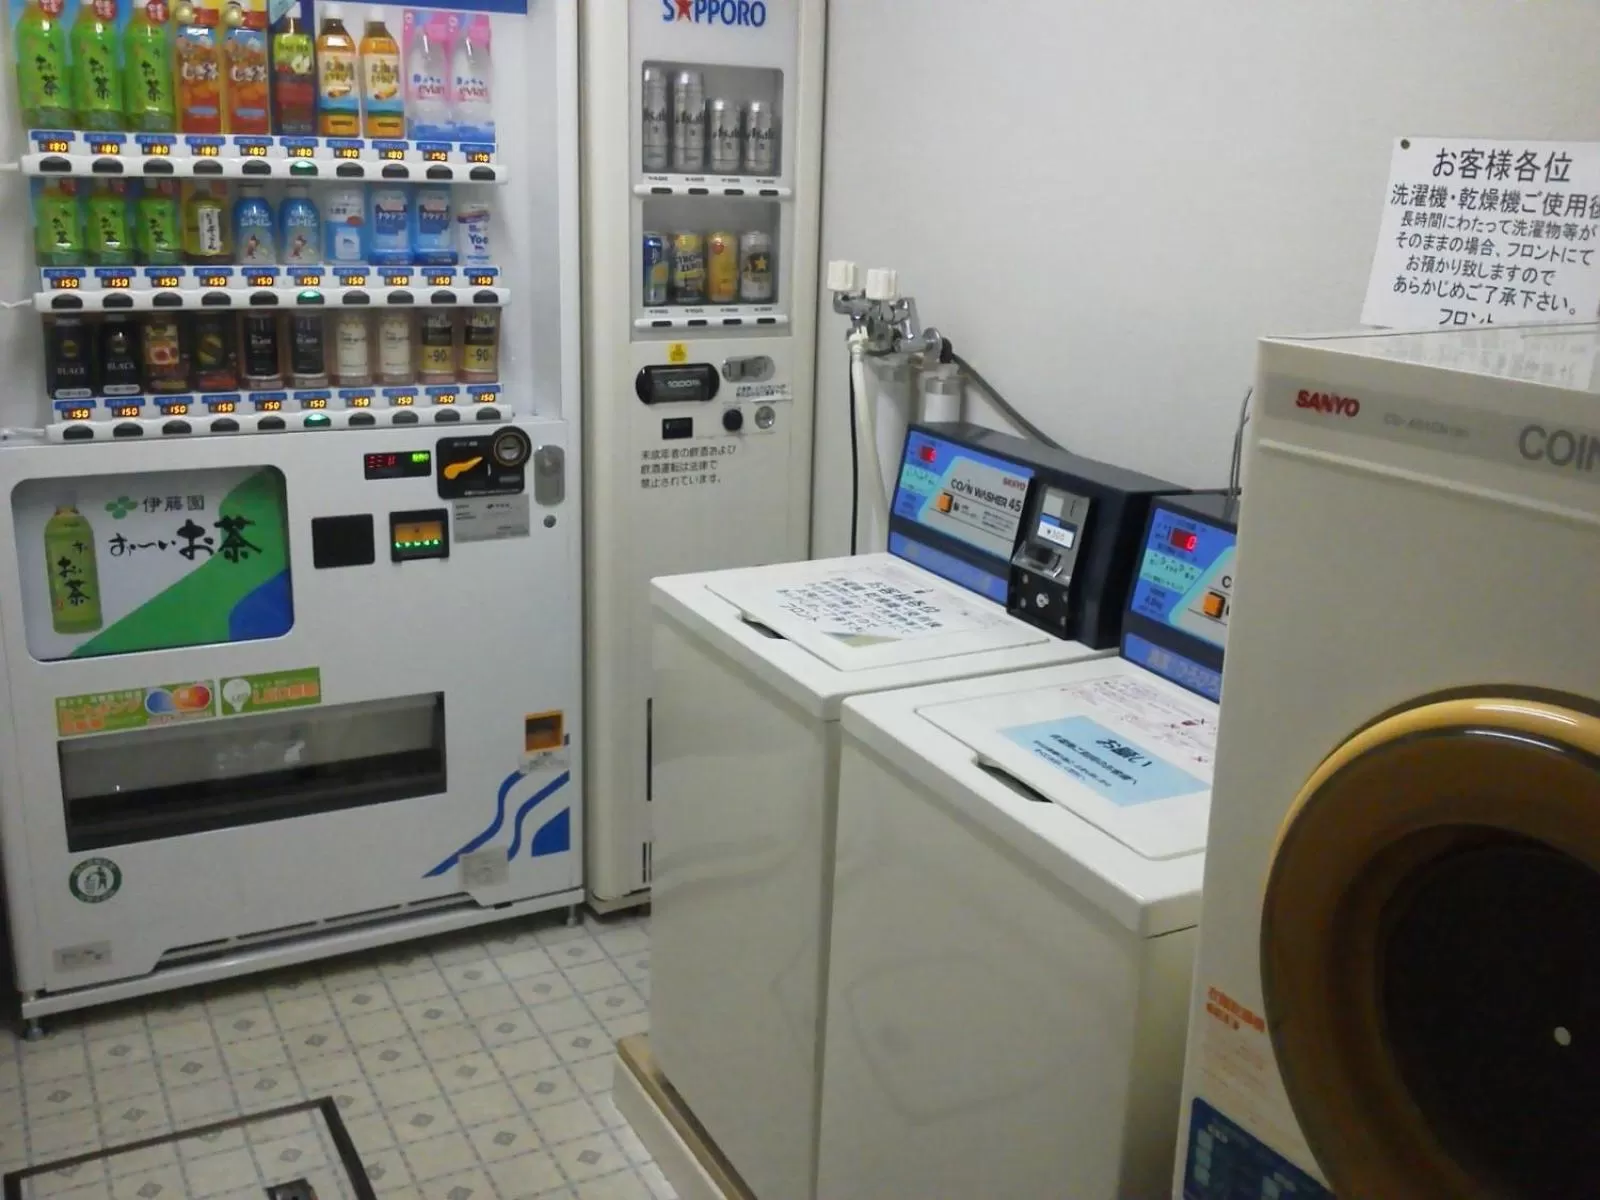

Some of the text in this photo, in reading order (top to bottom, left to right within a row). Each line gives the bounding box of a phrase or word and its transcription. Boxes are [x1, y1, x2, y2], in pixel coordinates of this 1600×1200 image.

[1433, 147, 1573, 183] お客様各位
[1401, 210, 1595, 241] 長時間にわたって洗濯物等が
[1396, 231, 1595, 266] そのままの場合、フロントにて
[1406, 254, 1556, 286] お預かり致しますので
[61, 279, 78, 287] 150
[112, 279, 128, 287] 150
[161, 278, 177, 287] 150
[210, 278, 225, 286] 150
[257, 277, 273, 285] 150
[303, 277, 318, 285] 150
[348, 277, 364, 285] 150
[393, 277, 407, 285] 150
[436, 277, 450, 285] 150
[478, 277, 492, 285] 150
[1393, 275, 1576, 315] あらかじめご了承下さい。
[355, 398, 369, 406] 150
[398, 397, 412, 405] 150
[439, 395, 453, 403] 150
[481, 394, 494, 402] 150
[265, 402, 280, 410] 150
[310, 400, 325, 408] 150
[1295, 389, 1361, 418] SANYO
[122, 407, 138, 416] 150
[170, 405, 186, 414] 150
[218, 404, 233, 412] 150
[72, 409, 88, 418] 150
[142, 495, 205, 513] 伊藤園
[1009, 498, 1022, 512] 45
